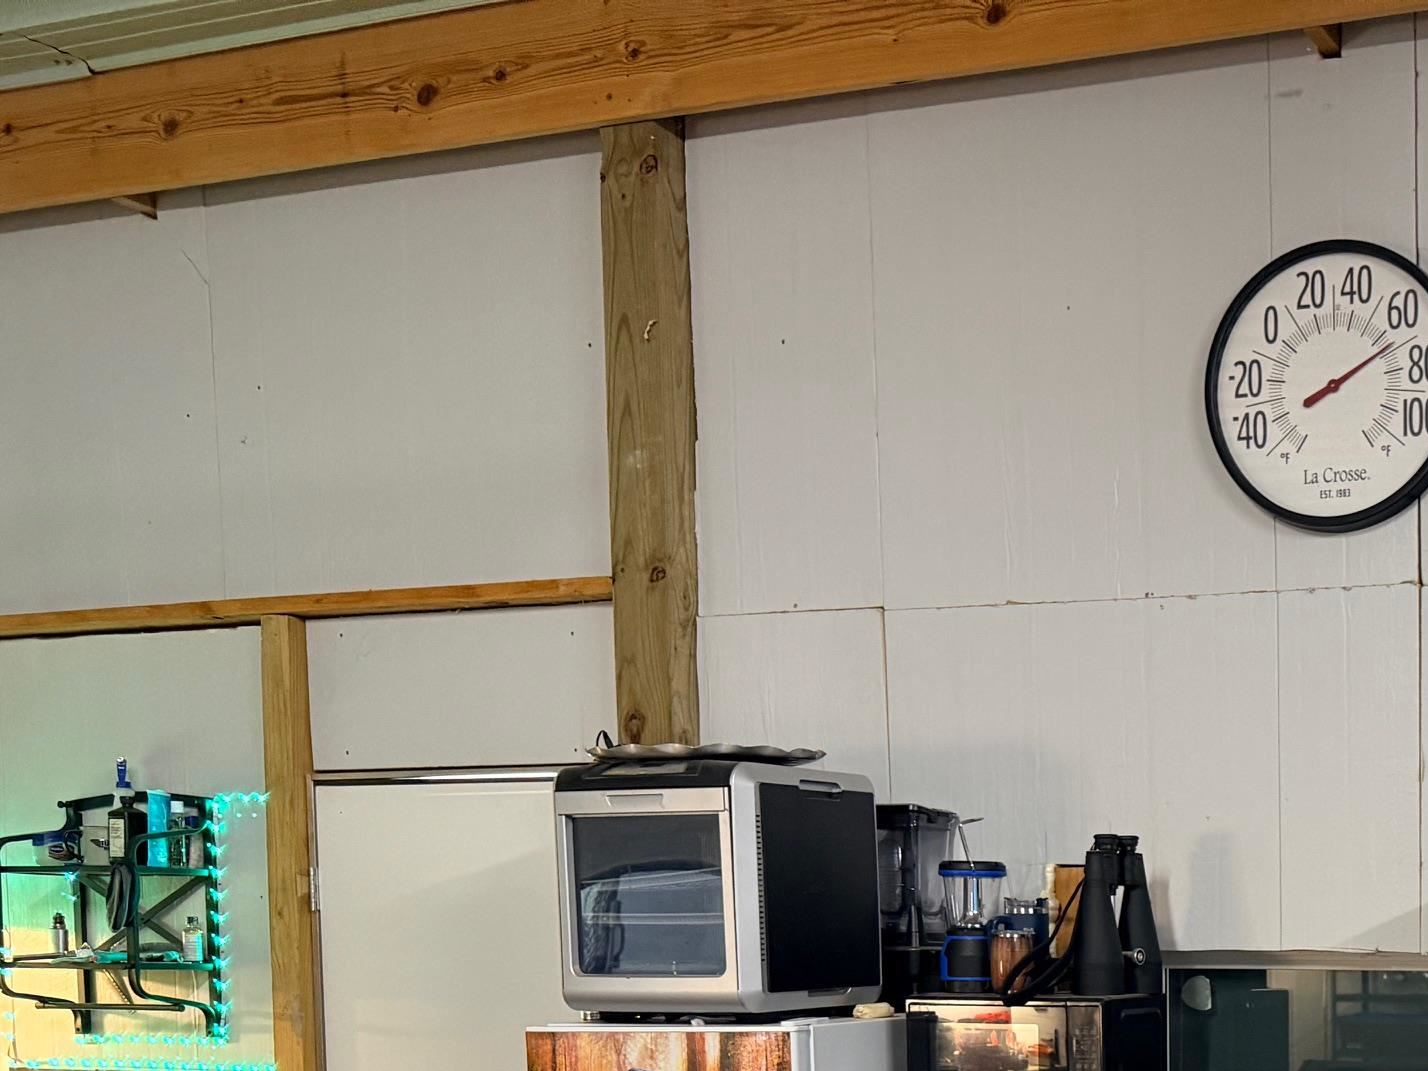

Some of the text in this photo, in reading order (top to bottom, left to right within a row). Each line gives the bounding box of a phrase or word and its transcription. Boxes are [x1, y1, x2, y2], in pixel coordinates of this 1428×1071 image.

[1296, 269, 1326, 310] 20
[1340, 264, 1373, 305] 40
[1264, 305, 1279, 344] 0
[1387, 288, 1419, 329] 60
[1228, 359, 1263, 399] -20
[1232, 410, 1268, 449] -40
[1303, 469, 1319, 485] La
